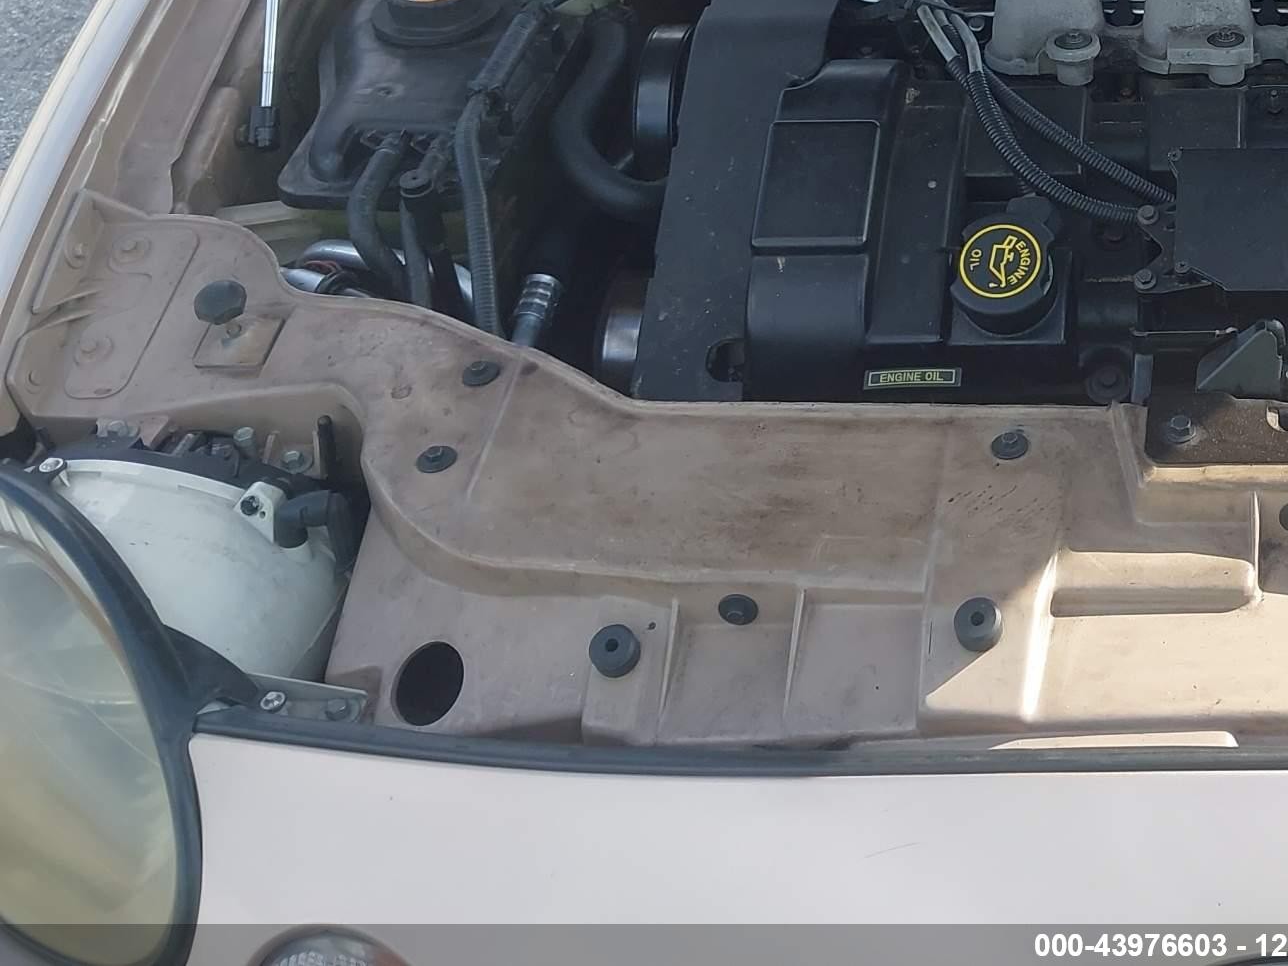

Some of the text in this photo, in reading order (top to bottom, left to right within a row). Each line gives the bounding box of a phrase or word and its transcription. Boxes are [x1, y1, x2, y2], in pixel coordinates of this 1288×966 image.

[969, 249, 982, 271] OIL
[1006, 240, 1031, 286] ENGINE
[879, 371, 944, 383] ENGINE OIL
